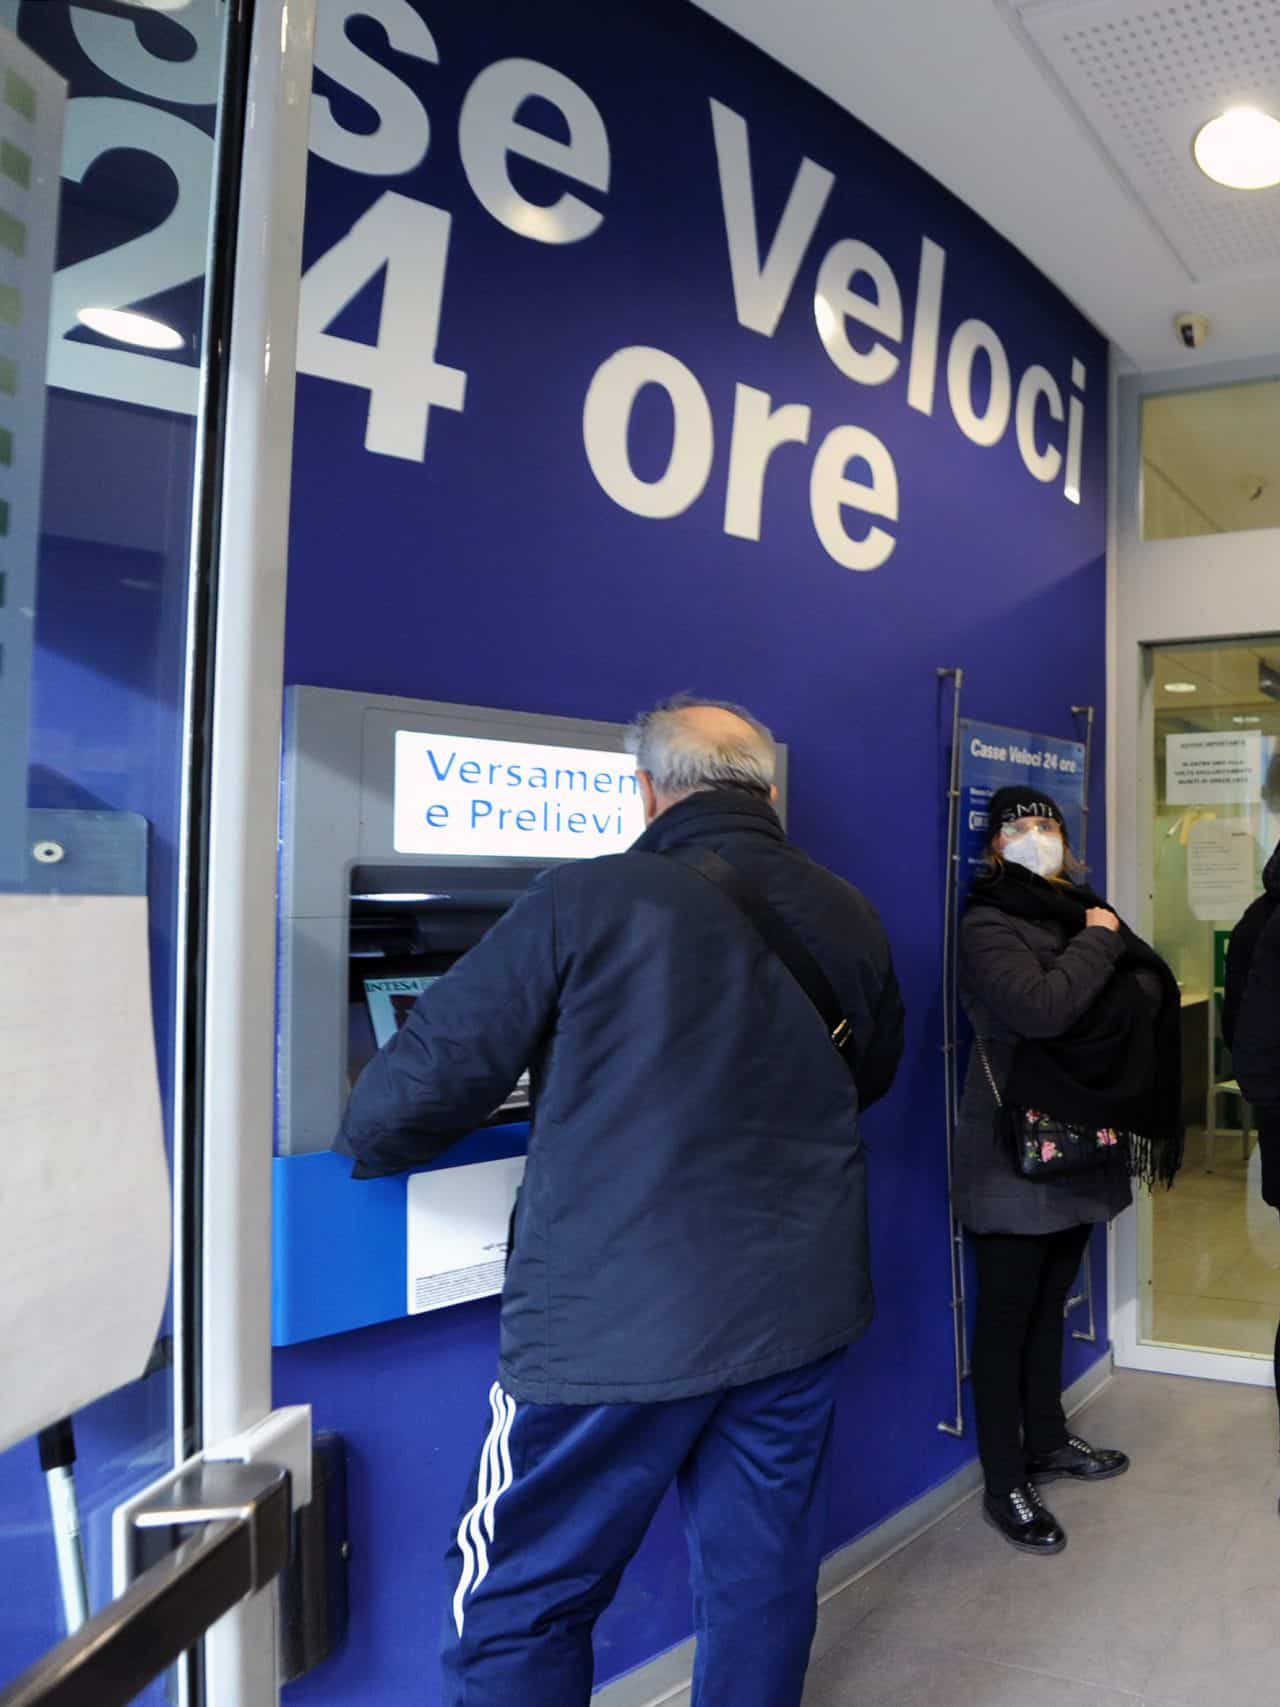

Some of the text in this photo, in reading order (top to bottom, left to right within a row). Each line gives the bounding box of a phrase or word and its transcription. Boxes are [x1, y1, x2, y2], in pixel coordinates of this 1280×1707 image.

[709, 96, 1087, 505] Veloci
[46, 96, 900, 572] 24 ore
[426, 749, 638, 795] Versamen
[971, 738, 1077, 774] Casse Veloci 24 ore
[425, 799, 622, 835] e Prelievi
